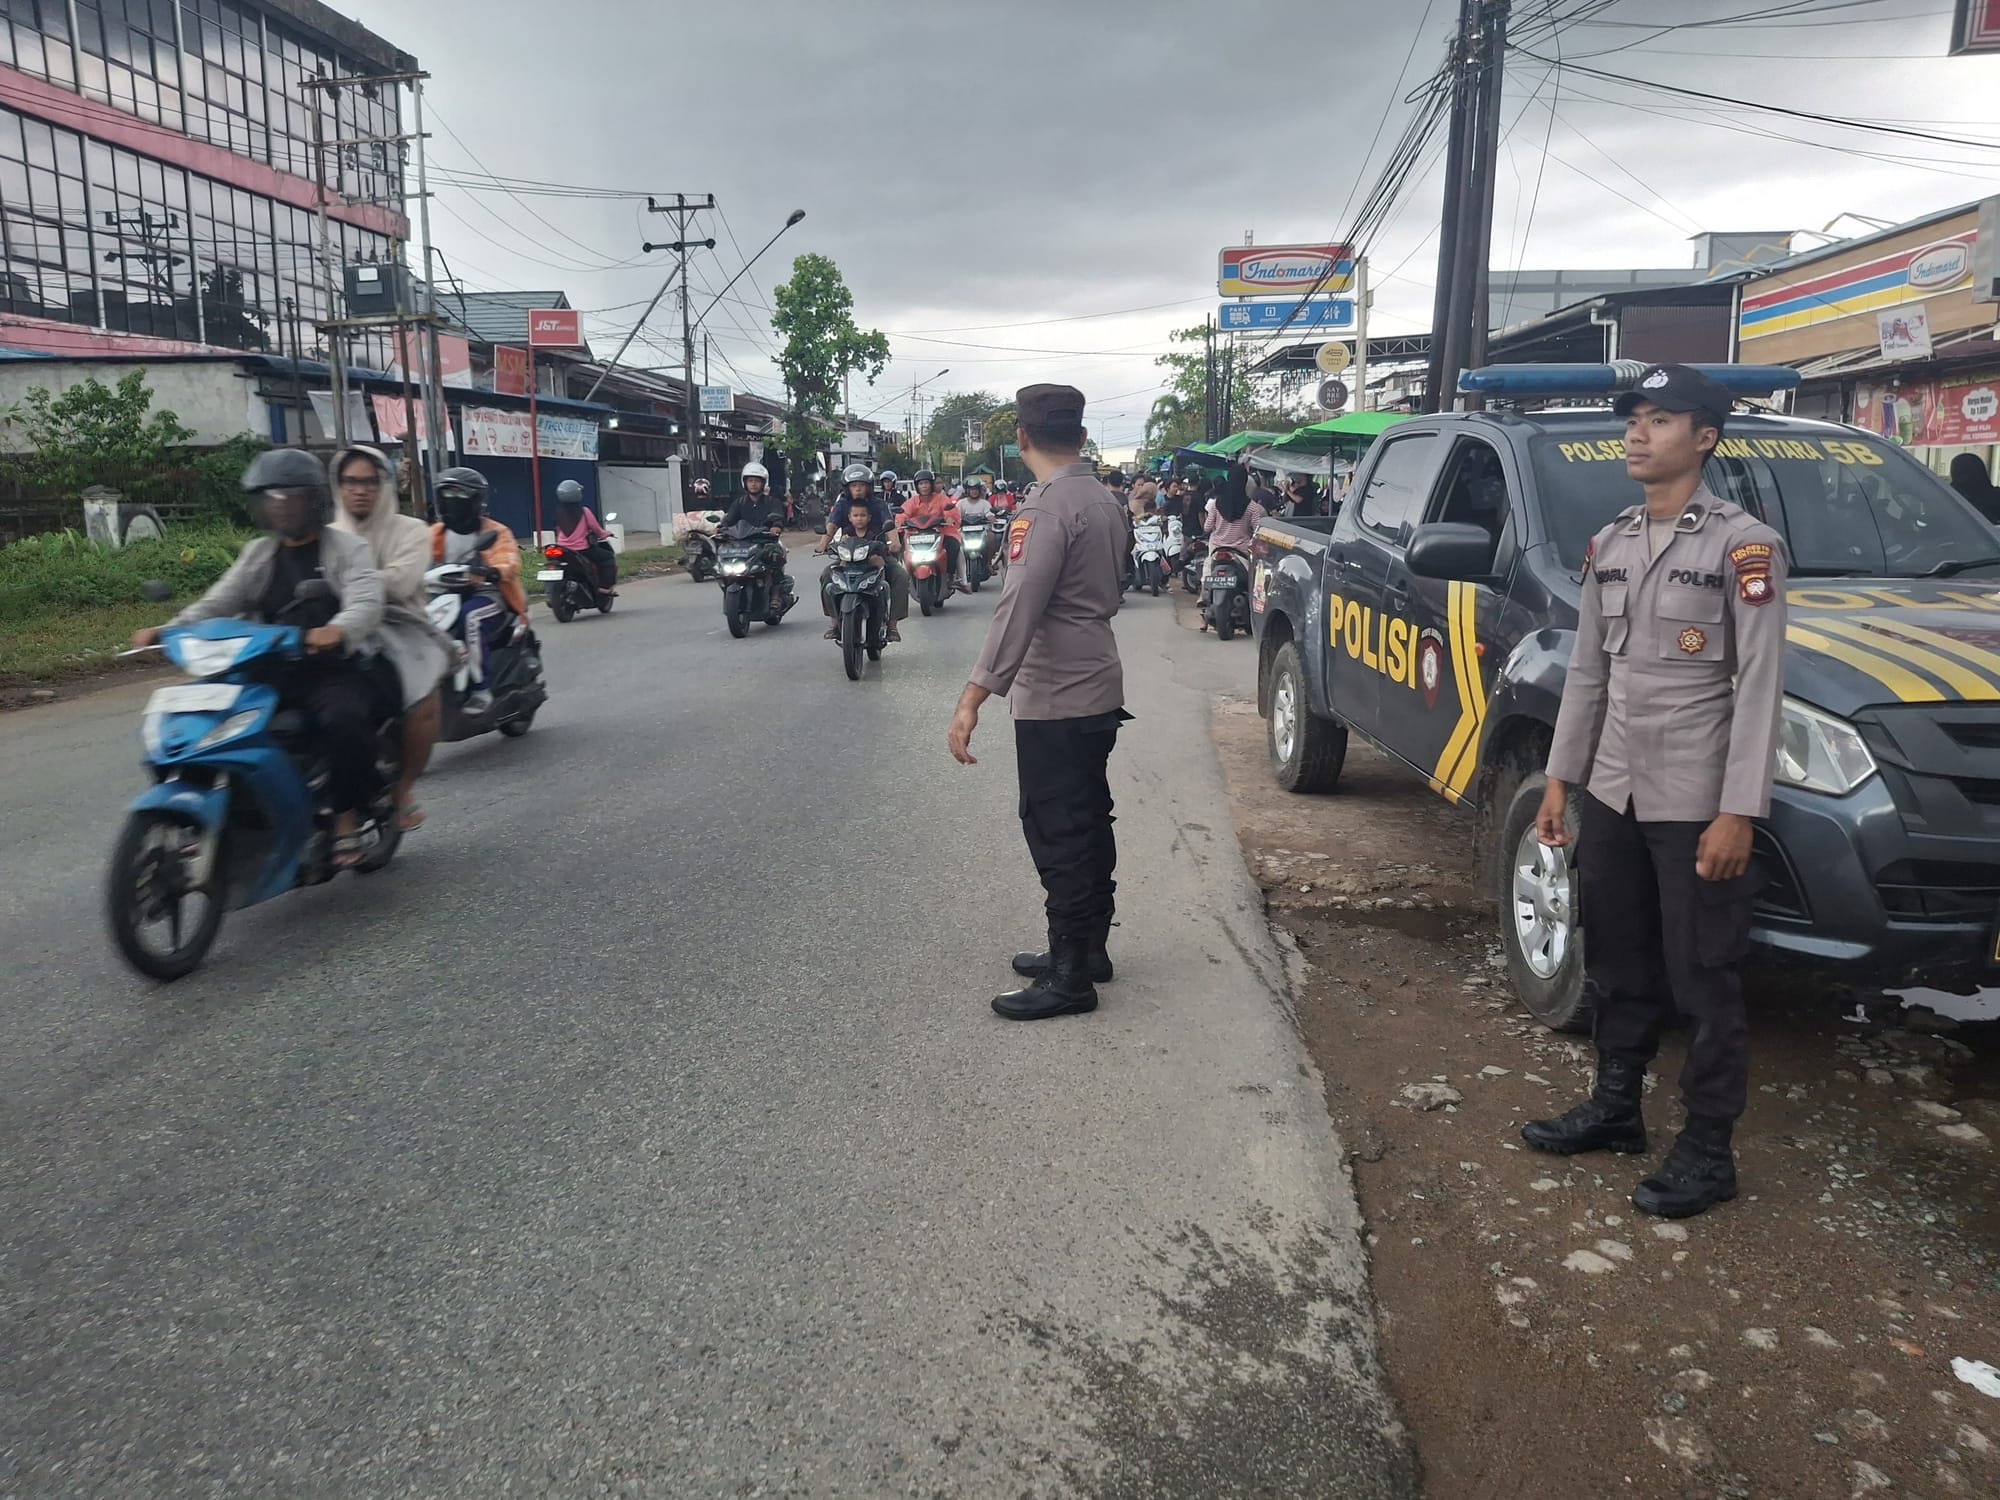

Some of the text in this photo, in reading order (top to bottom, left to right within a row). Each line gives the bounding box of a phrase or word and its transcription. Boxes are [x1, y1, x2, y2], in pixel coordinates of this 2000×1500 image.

[1245, 261, 1332, 280] Indomaret
[534, 320, 559, 331] J&T
[1558, 439, 1626, 462] POLSE
[1753, 438, 1824, 460] UTARA
[1821, 441, 1884, 465] 5B
[1667, 568, 1726, 589] POLRI
[1329, 592, 1419, 691] POLISI
